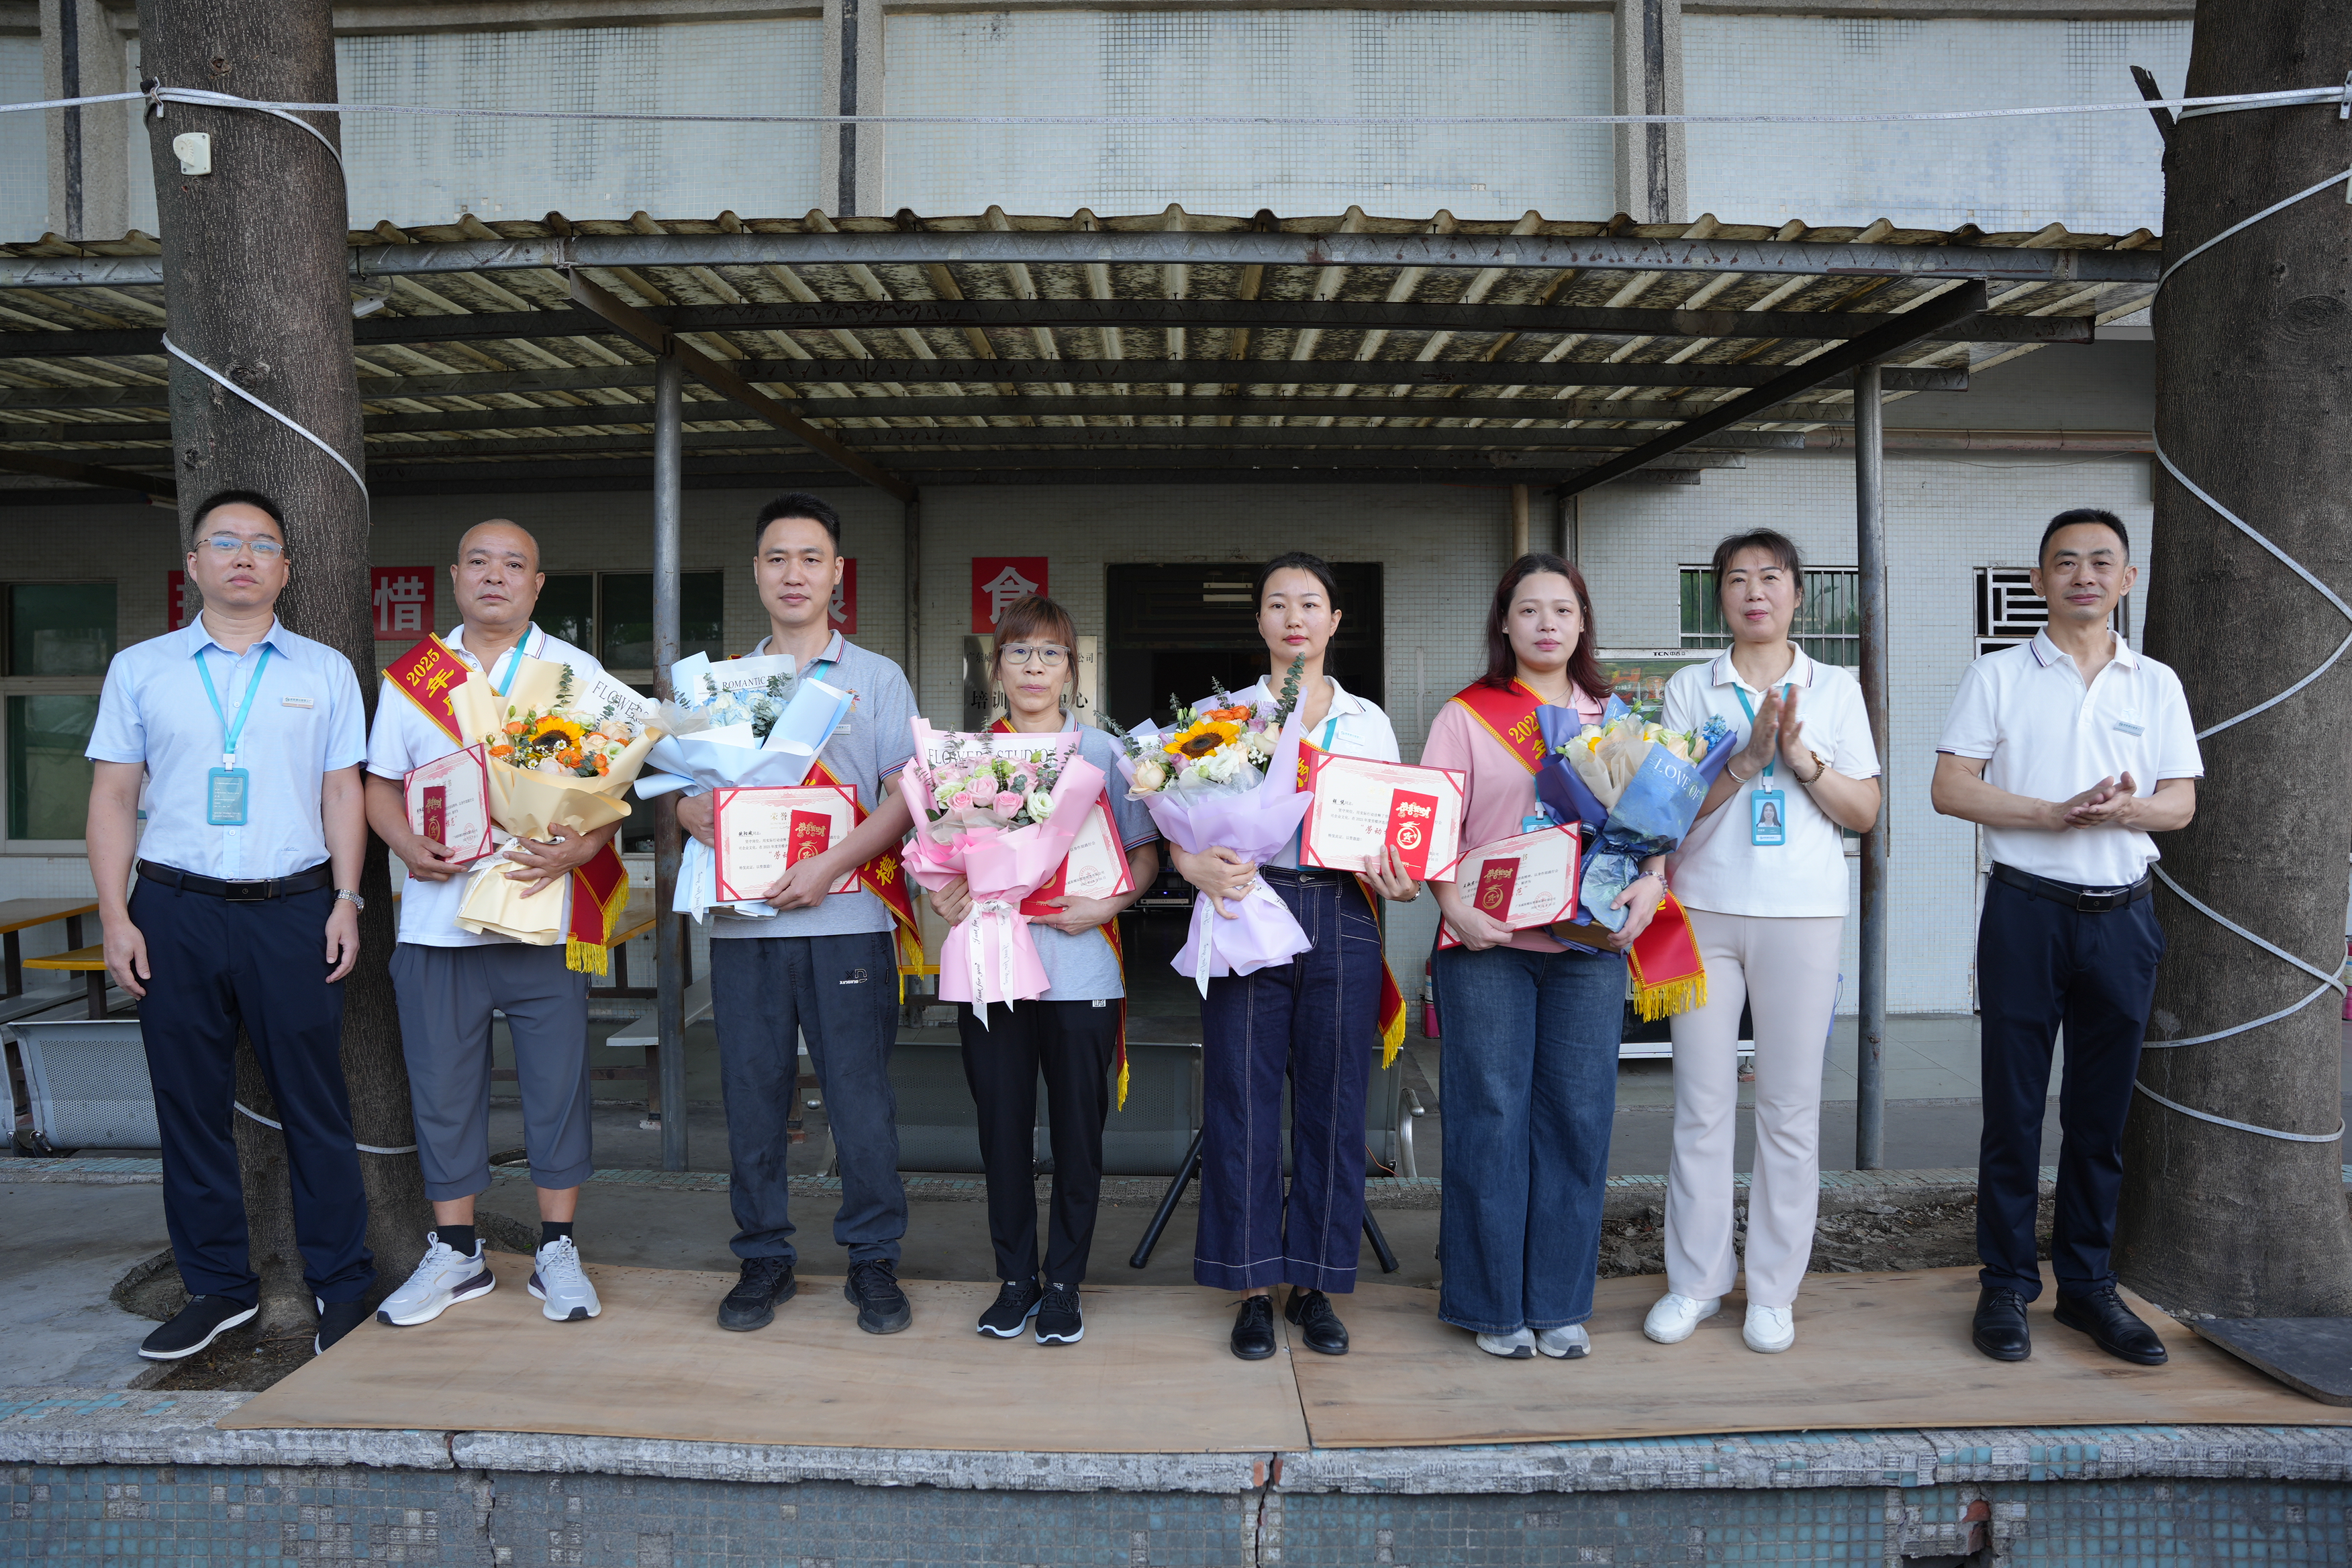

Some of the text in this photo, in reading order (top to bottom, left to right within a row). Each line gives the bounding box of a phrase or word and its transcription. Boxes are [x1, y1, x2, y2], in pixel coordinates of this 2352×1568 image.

[373, 565, 1039, 632] 惜 食
[405, 647, 440, 687] 2025
[722, 676, 766, 690] ROMANTIC
[997, 748, 1048, 765] STUDO
[1653, 758, 1702, 800] LOVE OF
[770, 812, 792, 821] 荣誉
[875, 854, 899, 887] 模
[975, 978, 984, 991] for
[976, 990, 984, 1005] Just
